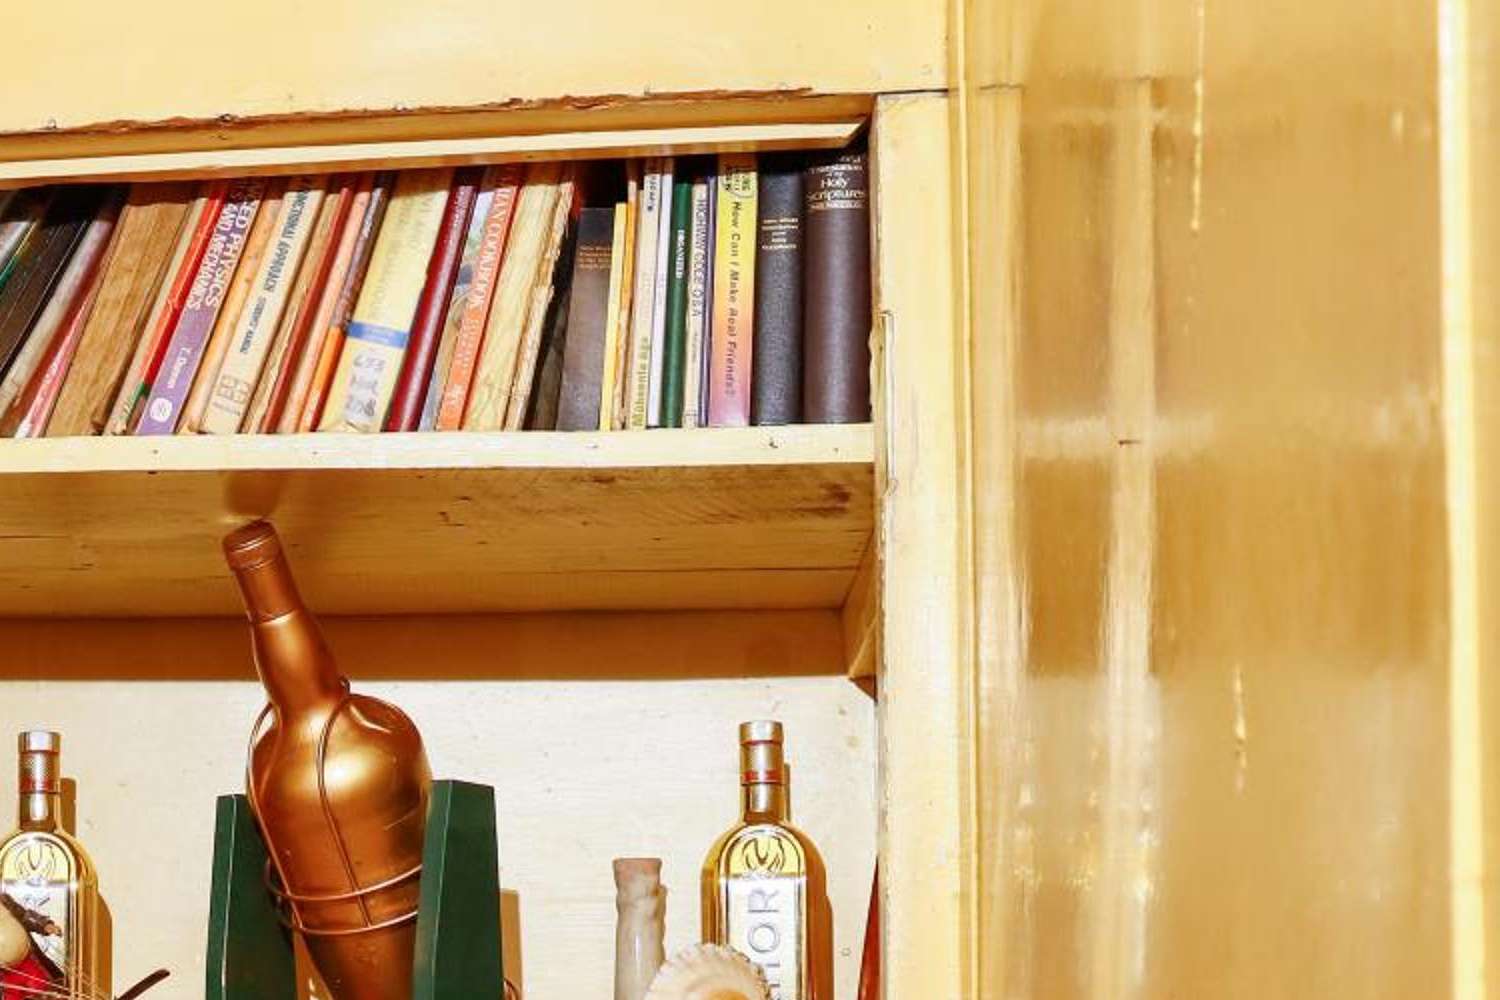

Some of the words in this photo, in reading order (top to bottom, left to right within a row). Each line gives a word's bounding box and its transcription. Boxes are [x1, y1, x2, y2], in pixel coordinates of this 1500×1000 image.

[820, 177, 848, 190] Holy
[731, 201, 742, 229] How
[730, 232, 741, 257] Can
[202, 231, 245, 310] PHYSICS
[468, 220, 504, 313] COOKBOOK
[728, 270, 740, 304] Make
[727, 307, 739, 338] Real
